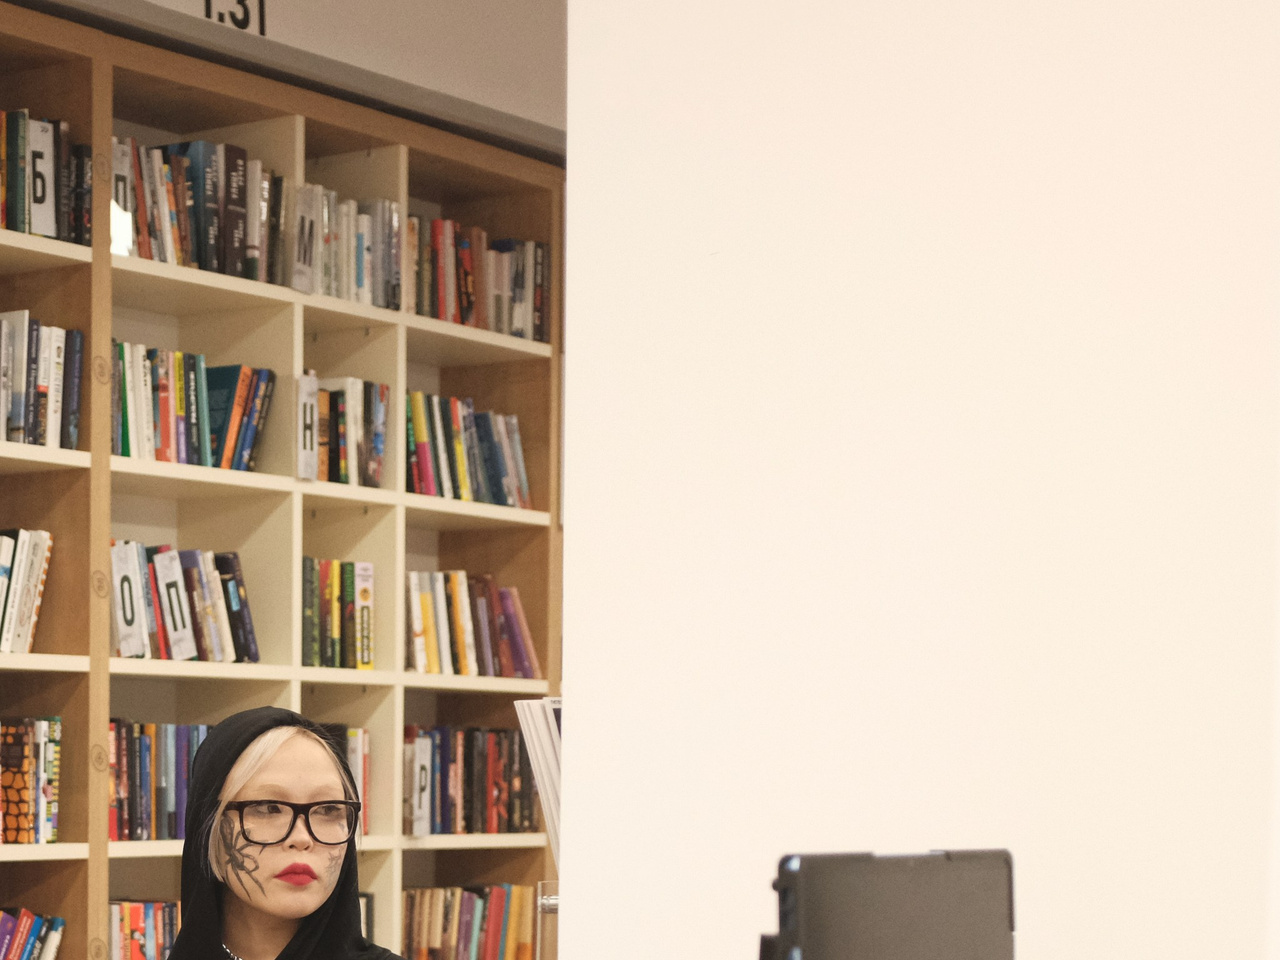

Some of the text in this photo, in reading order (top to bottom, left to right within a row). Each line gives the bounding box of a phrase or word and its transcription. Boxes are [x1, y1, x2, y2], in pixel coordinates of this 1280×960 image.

[33, 150, 46, 204] Б
[302, 401, 315, 451] Н
[120, 574, 135, 627] О
[165, 580, 187, 632] П
